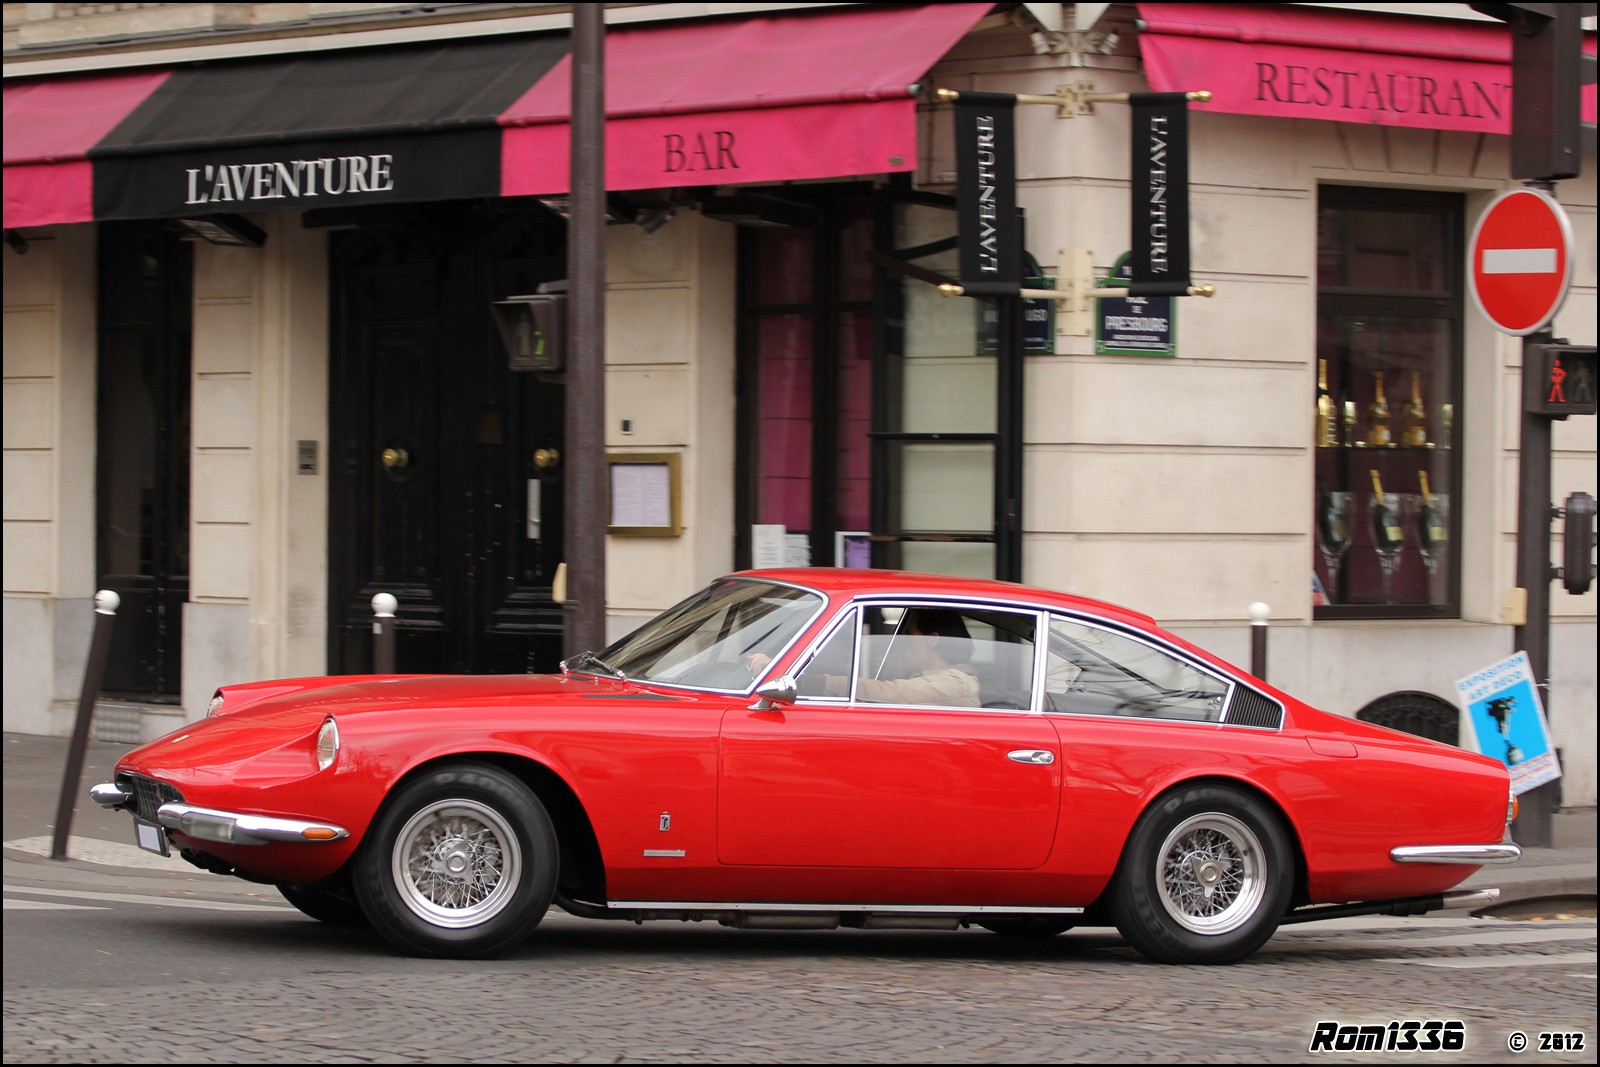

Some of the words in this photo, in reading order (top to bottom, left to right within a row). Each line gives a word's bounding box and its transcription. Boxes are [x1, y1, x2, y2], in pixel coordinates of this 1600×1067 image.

[662, 130, 741, 173] BAR
[184, 154, 394, 204] L'AVENTURE
[977, 115, 998, 273] L'AVENTURE
[1150, 115, 1168, 273] L'AVENTURE
[1025, 308, 1048, 321] UGO
[1105, 315, 1168, 332] PRESBOURG
[1458, 655, 1525, 691] EXPOSITION
[1469, 685, 1490, 700] ART
